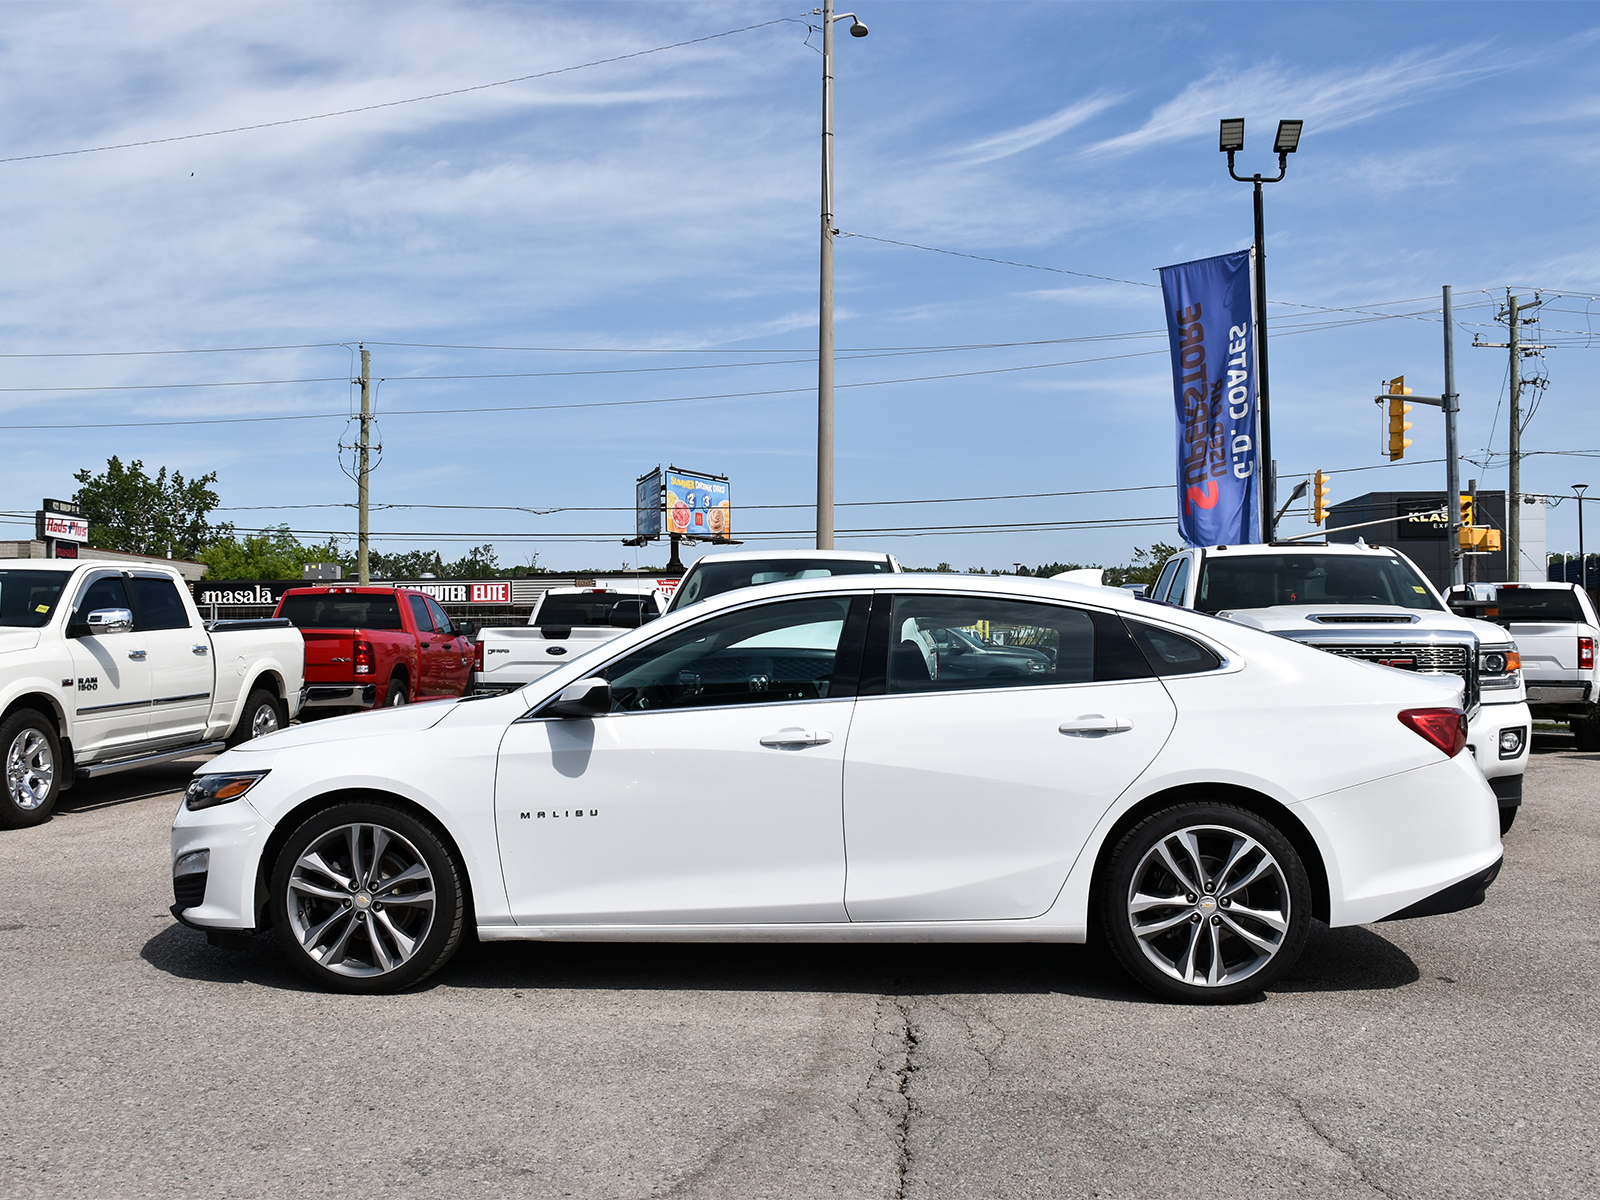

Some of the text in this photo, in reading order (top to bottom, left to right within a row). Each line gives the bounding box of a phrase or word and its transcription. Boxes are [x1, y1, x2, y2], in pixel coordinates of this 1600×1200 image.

[671, 476, 695, 490] SUMMER
[695, 480, 713, 492] DRINK
[1408, 512, 1449, 522] KLAS
[46, 518, 87, 537] Rads Plus
[400, 584, 506, 602] PUTER ELITE
[78, 683, 98, 691] 1500
[520, 809, 599, 820] MALIBU
